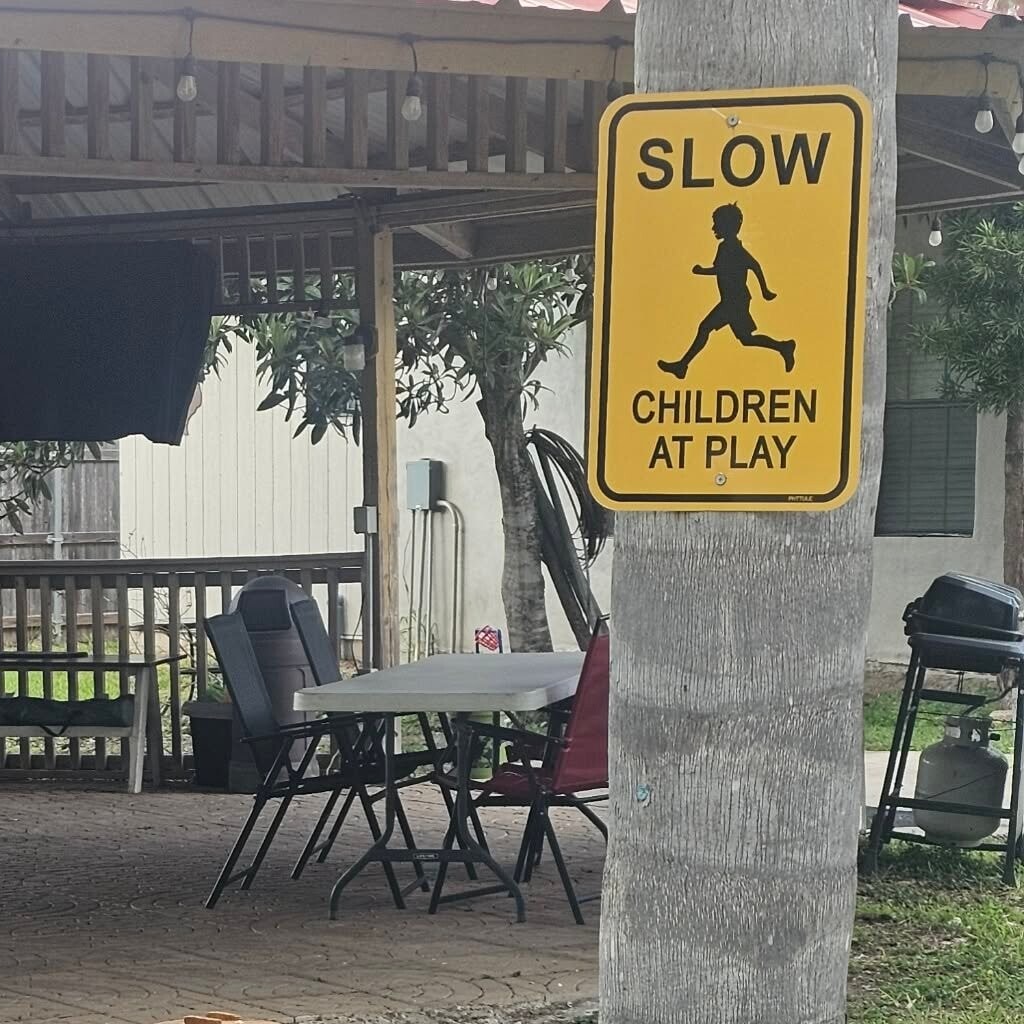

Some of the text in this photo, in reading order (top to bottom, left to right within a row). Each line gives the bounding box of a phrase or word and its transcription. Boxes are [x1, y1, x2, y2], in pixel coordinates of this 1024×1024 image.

[638, 132, 831, 189] SLOW
[632, 389, 817, 425] CHILDREN
[649, 435, 797, 469] AT PLAY
